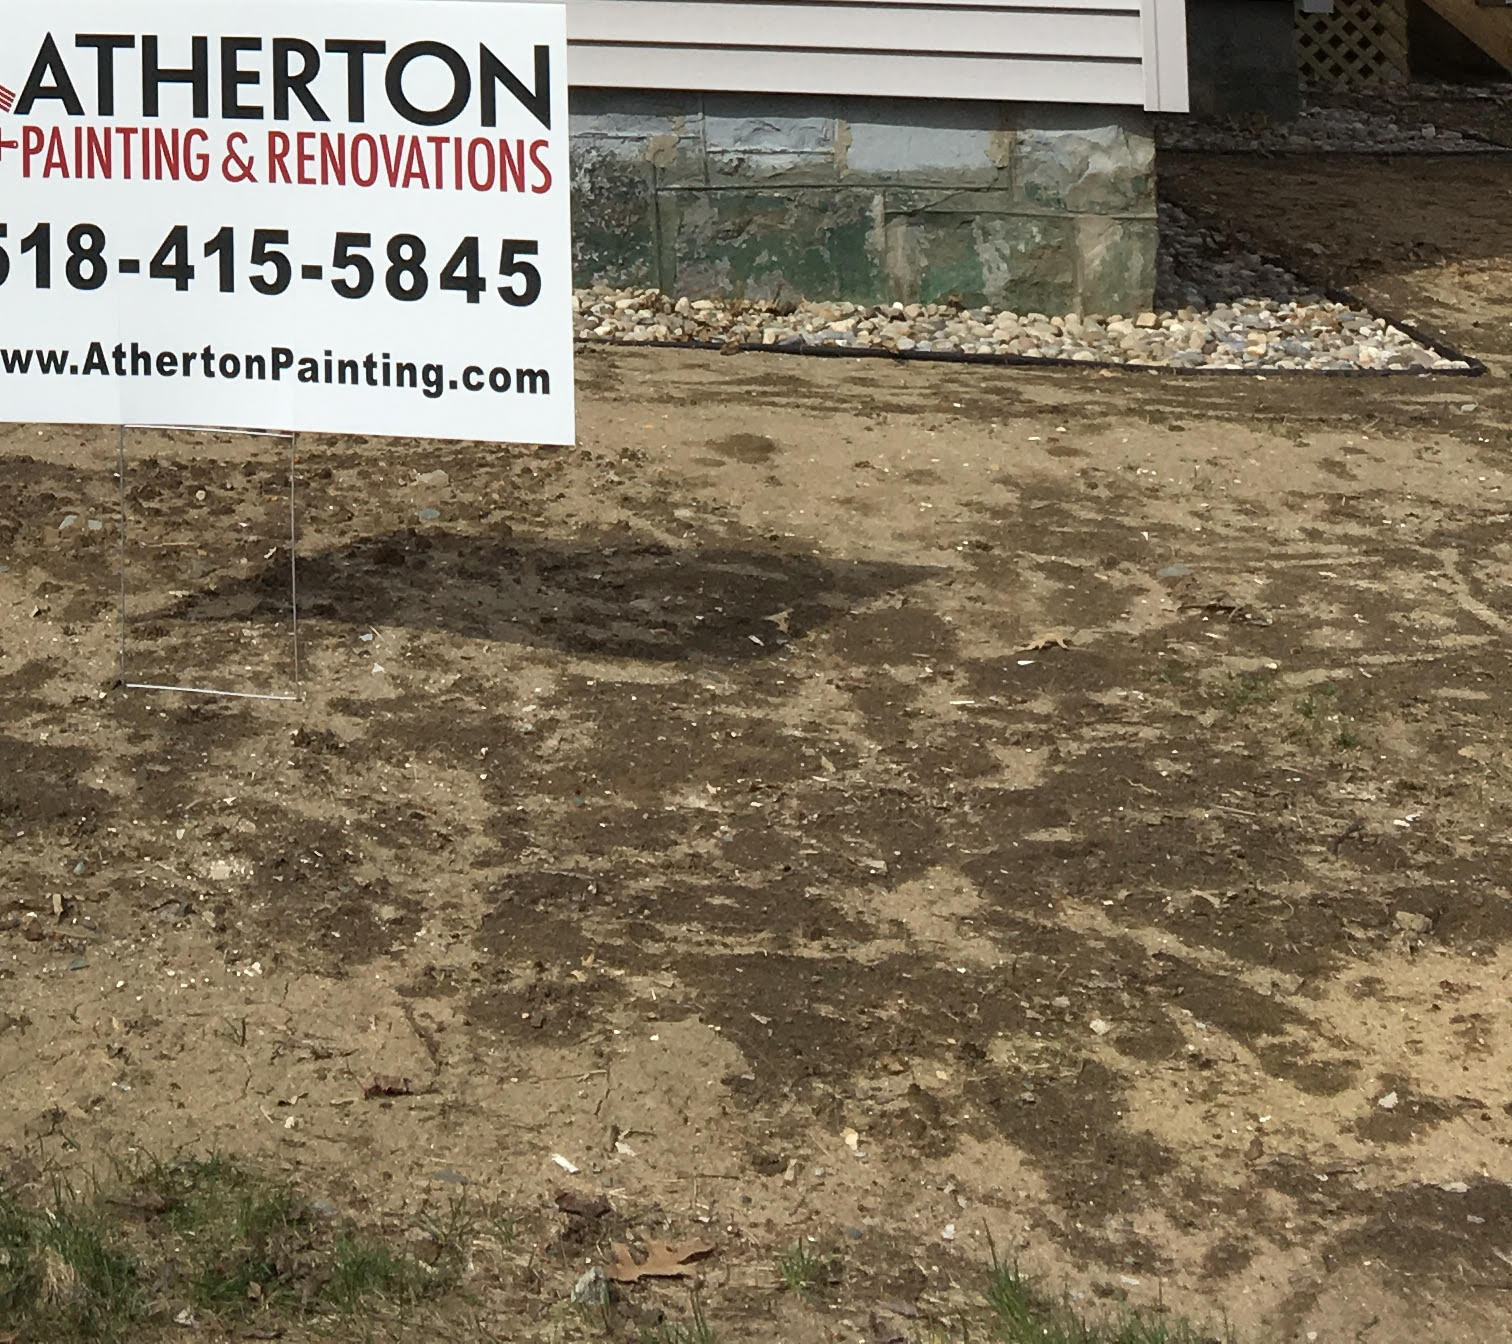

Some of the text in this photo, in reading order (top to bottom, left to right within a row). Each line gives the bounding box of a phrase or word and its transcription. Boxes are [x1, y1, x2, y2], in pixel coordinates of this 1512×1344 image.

[13, 31, 551, 131] ATHERTON
[22, 124, 552, 194] PAINTING & RENOVATIONS
